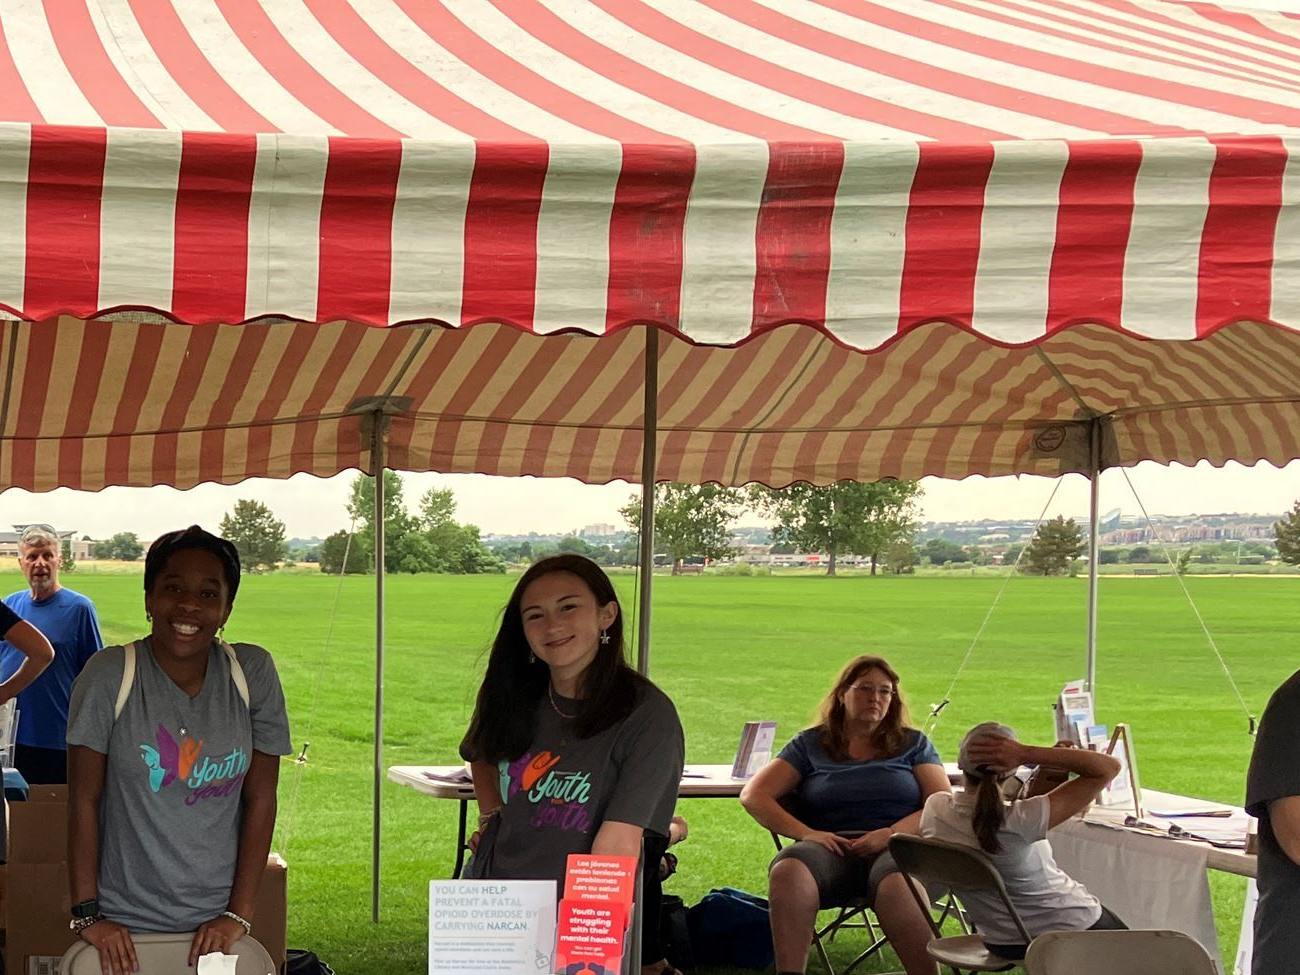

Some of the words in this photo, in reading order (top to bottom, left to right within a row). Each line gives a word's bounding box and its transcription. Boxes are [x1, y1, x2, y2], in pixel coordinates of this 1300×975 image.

[435, 886, 456, 895] YOU
[459, 886, 479, 895] CAN
[481, 886, 507, 895] HELP
[435, 898, 480, 907] PREVENT
[481, 898, 490, 907] A
[491, 898, 524, 907] FATAL
[435, 910, 469, 919] OPIOID
[471, 910, 524, 919] OVERDOSE
[526, 910, 540, 919] BY
[572, 907, 596, 916] Youth
[596, 909, 611, 917] are
[435, 922, 485, 931] CARRYING
[569, 917, 612, 928] struggling
[570, 925, 588, 934] with
[589, 926, 610, 935] their
[560, 934, 590, 942] mental
[590, 935, 619, 944] health.
